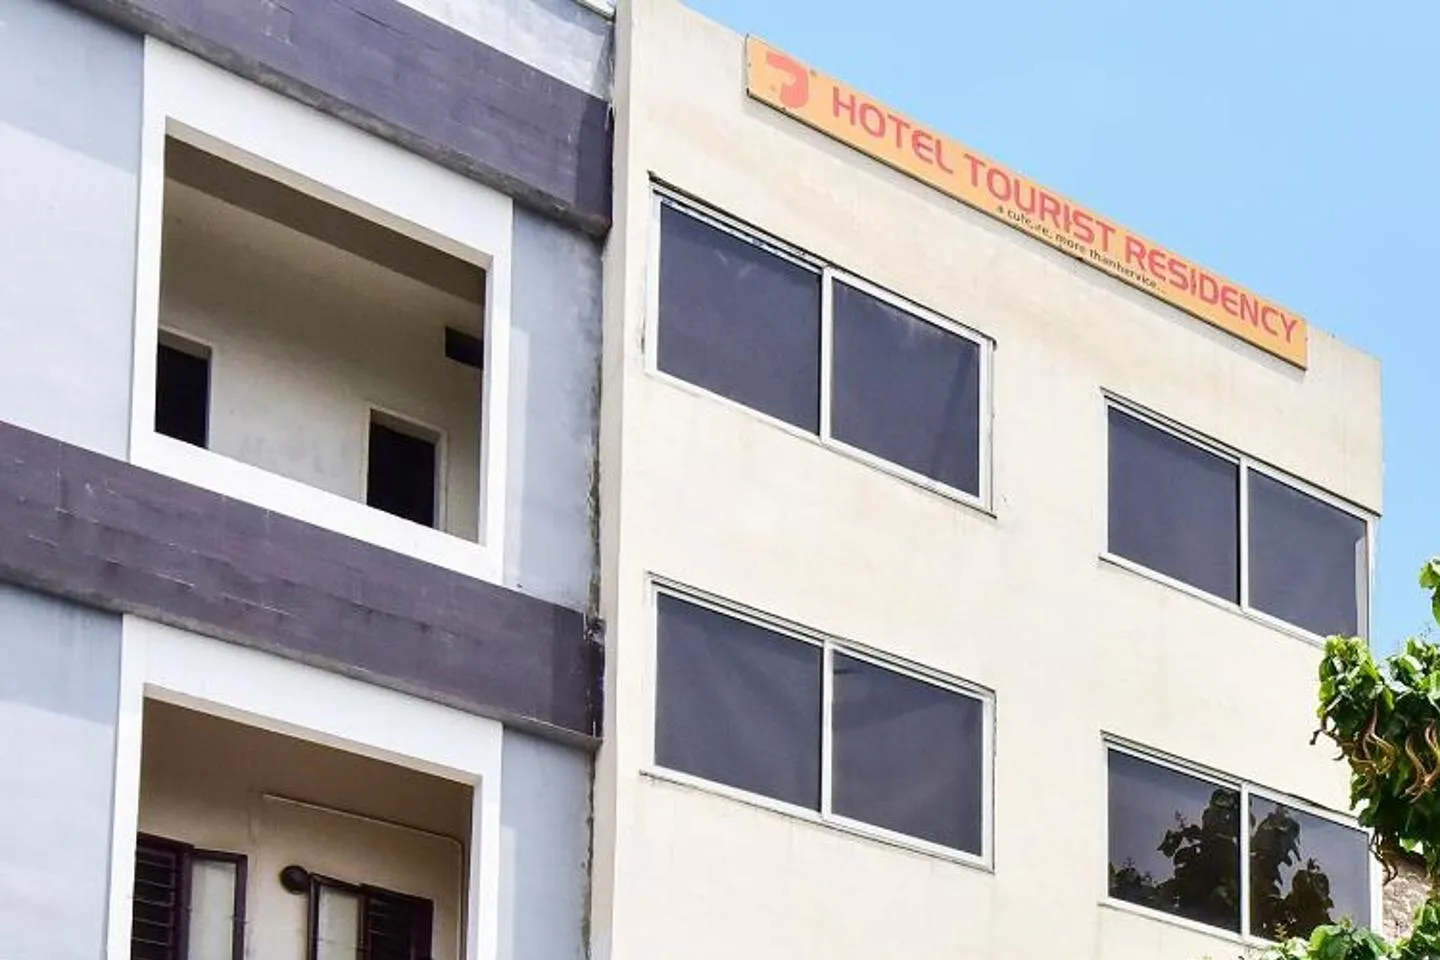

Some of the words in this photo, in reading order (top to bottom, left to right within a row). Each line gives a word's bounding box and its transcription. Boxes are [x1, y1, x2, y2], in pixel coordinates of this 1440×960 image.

[831, 86, 953, 174] HOTEL
[964, 153, 1116, 252] TOURIST
[1126, 238, 1299, 345] RESIDENCY
